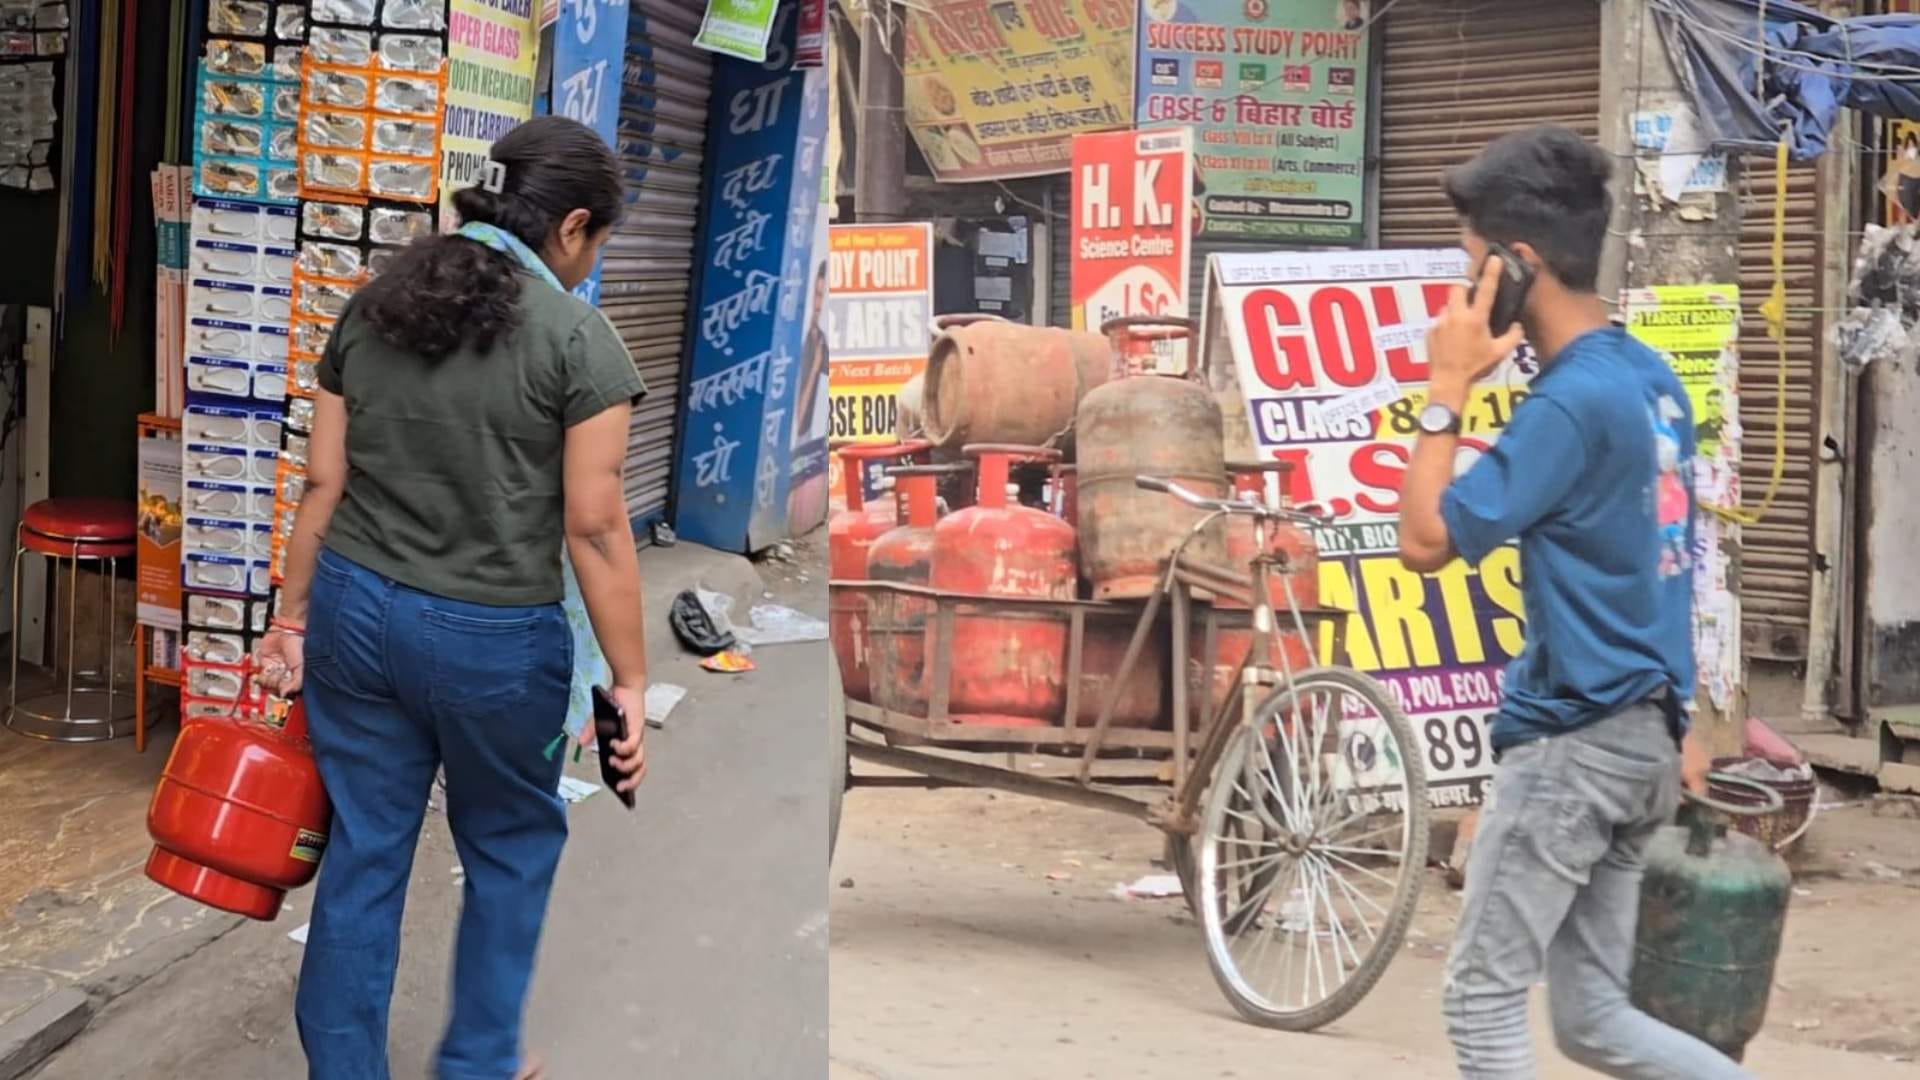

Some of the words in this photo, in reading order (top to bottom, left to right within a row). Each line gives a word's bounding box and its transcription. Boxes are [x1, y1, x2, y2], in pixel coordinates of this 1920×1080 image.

[483, 21, 520, 59] GLASS
[1148, 23, 1226, 53] SUCCESS
[1233, 28, 1294, 58] STUDY
[1301, 31, 1362, 60] POINT
[480, 66, 531, 105] NECKBAND
[1148, 96, 1204, 122] CBSE
[1213, 99, 1226, 123] &
[1235, 95, 1303, 126] बिहार
[1309, 98, 1356, 129] बोर्ड
[722, 153, 784, 207] दूध
[1082, 163, 1121, 229] H.
[1133, 159, 1172, 226] K.
[713, 209, 772, 270] दही
[1080, 236, 1129, 260] Science
[1131, 234, 1174, 256] Centre
[829, 250, 855, 288] DY
[858, 249, 920, 287] POINT
[846, 301, 922, 349] ARTS
[1646, 311, 1690, 325] TARGET
[1692, 309, 1734, 324] BOARD
[1242, 284, 1453, 391] GOL
[839, 363, 870, 378] Next
[873, 361, 912, 377] Batch
[691, 436, 741, 488] घी
[1318, 547, 1526, 673] ARTS
